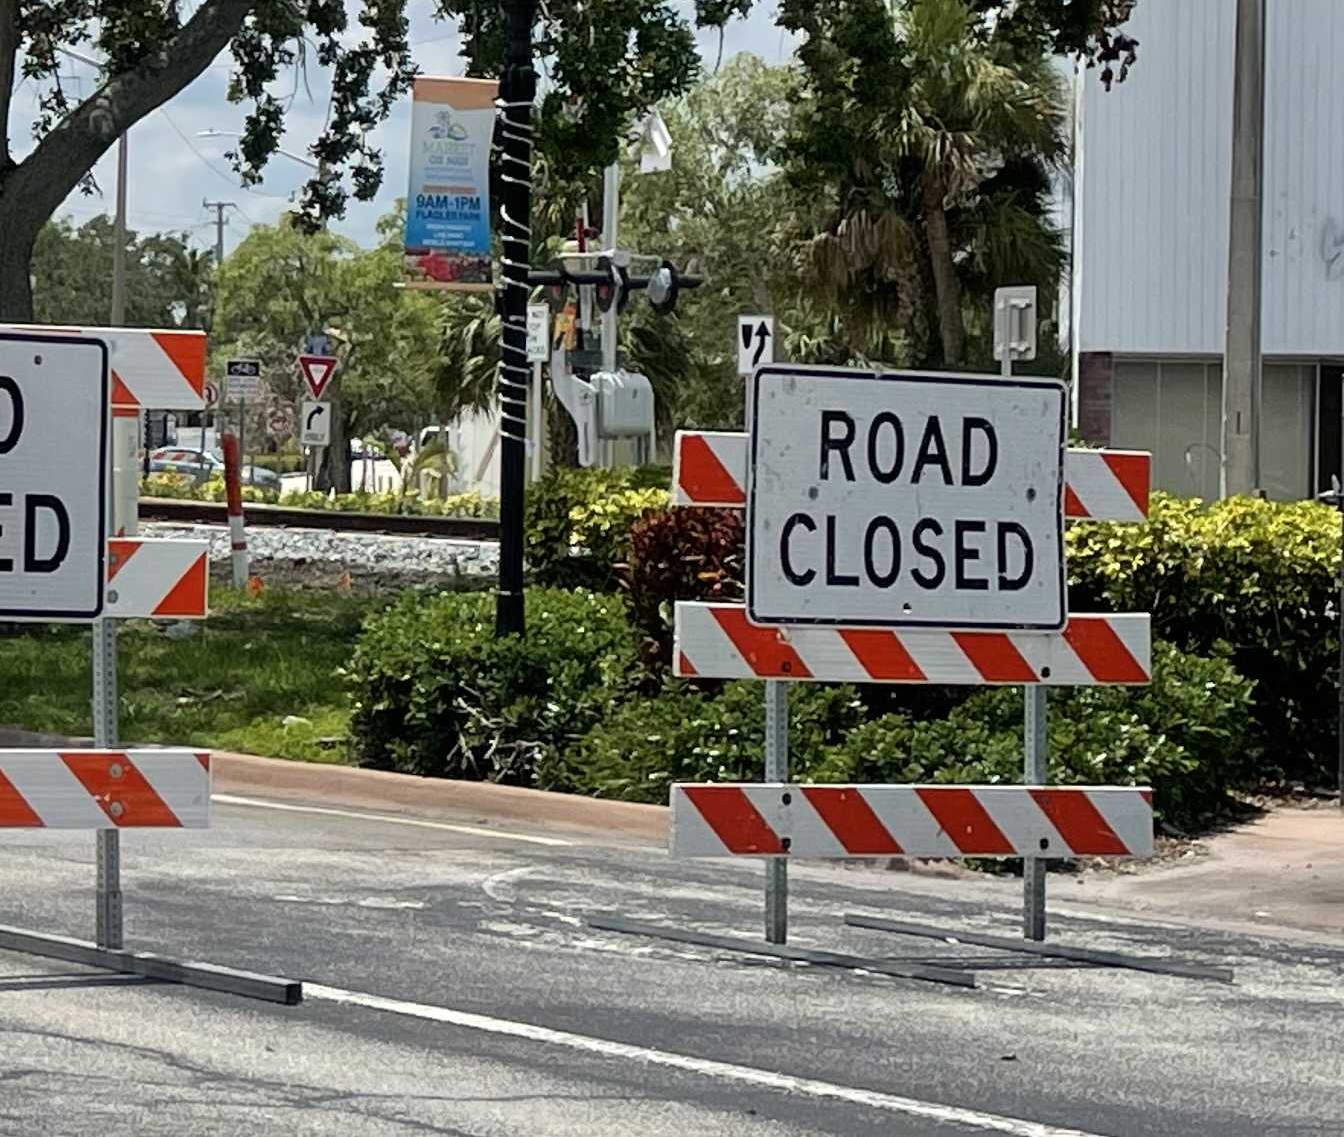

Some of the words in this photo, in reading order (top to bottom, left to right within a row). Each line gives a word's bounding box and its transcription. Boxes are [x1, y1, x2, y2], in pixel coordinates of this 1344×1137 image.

[415, 194, 481, 210] 9AM-1PM
[819, 410, 999, 487] ROAD
[779, 513, 1034, 591] CLOSED
